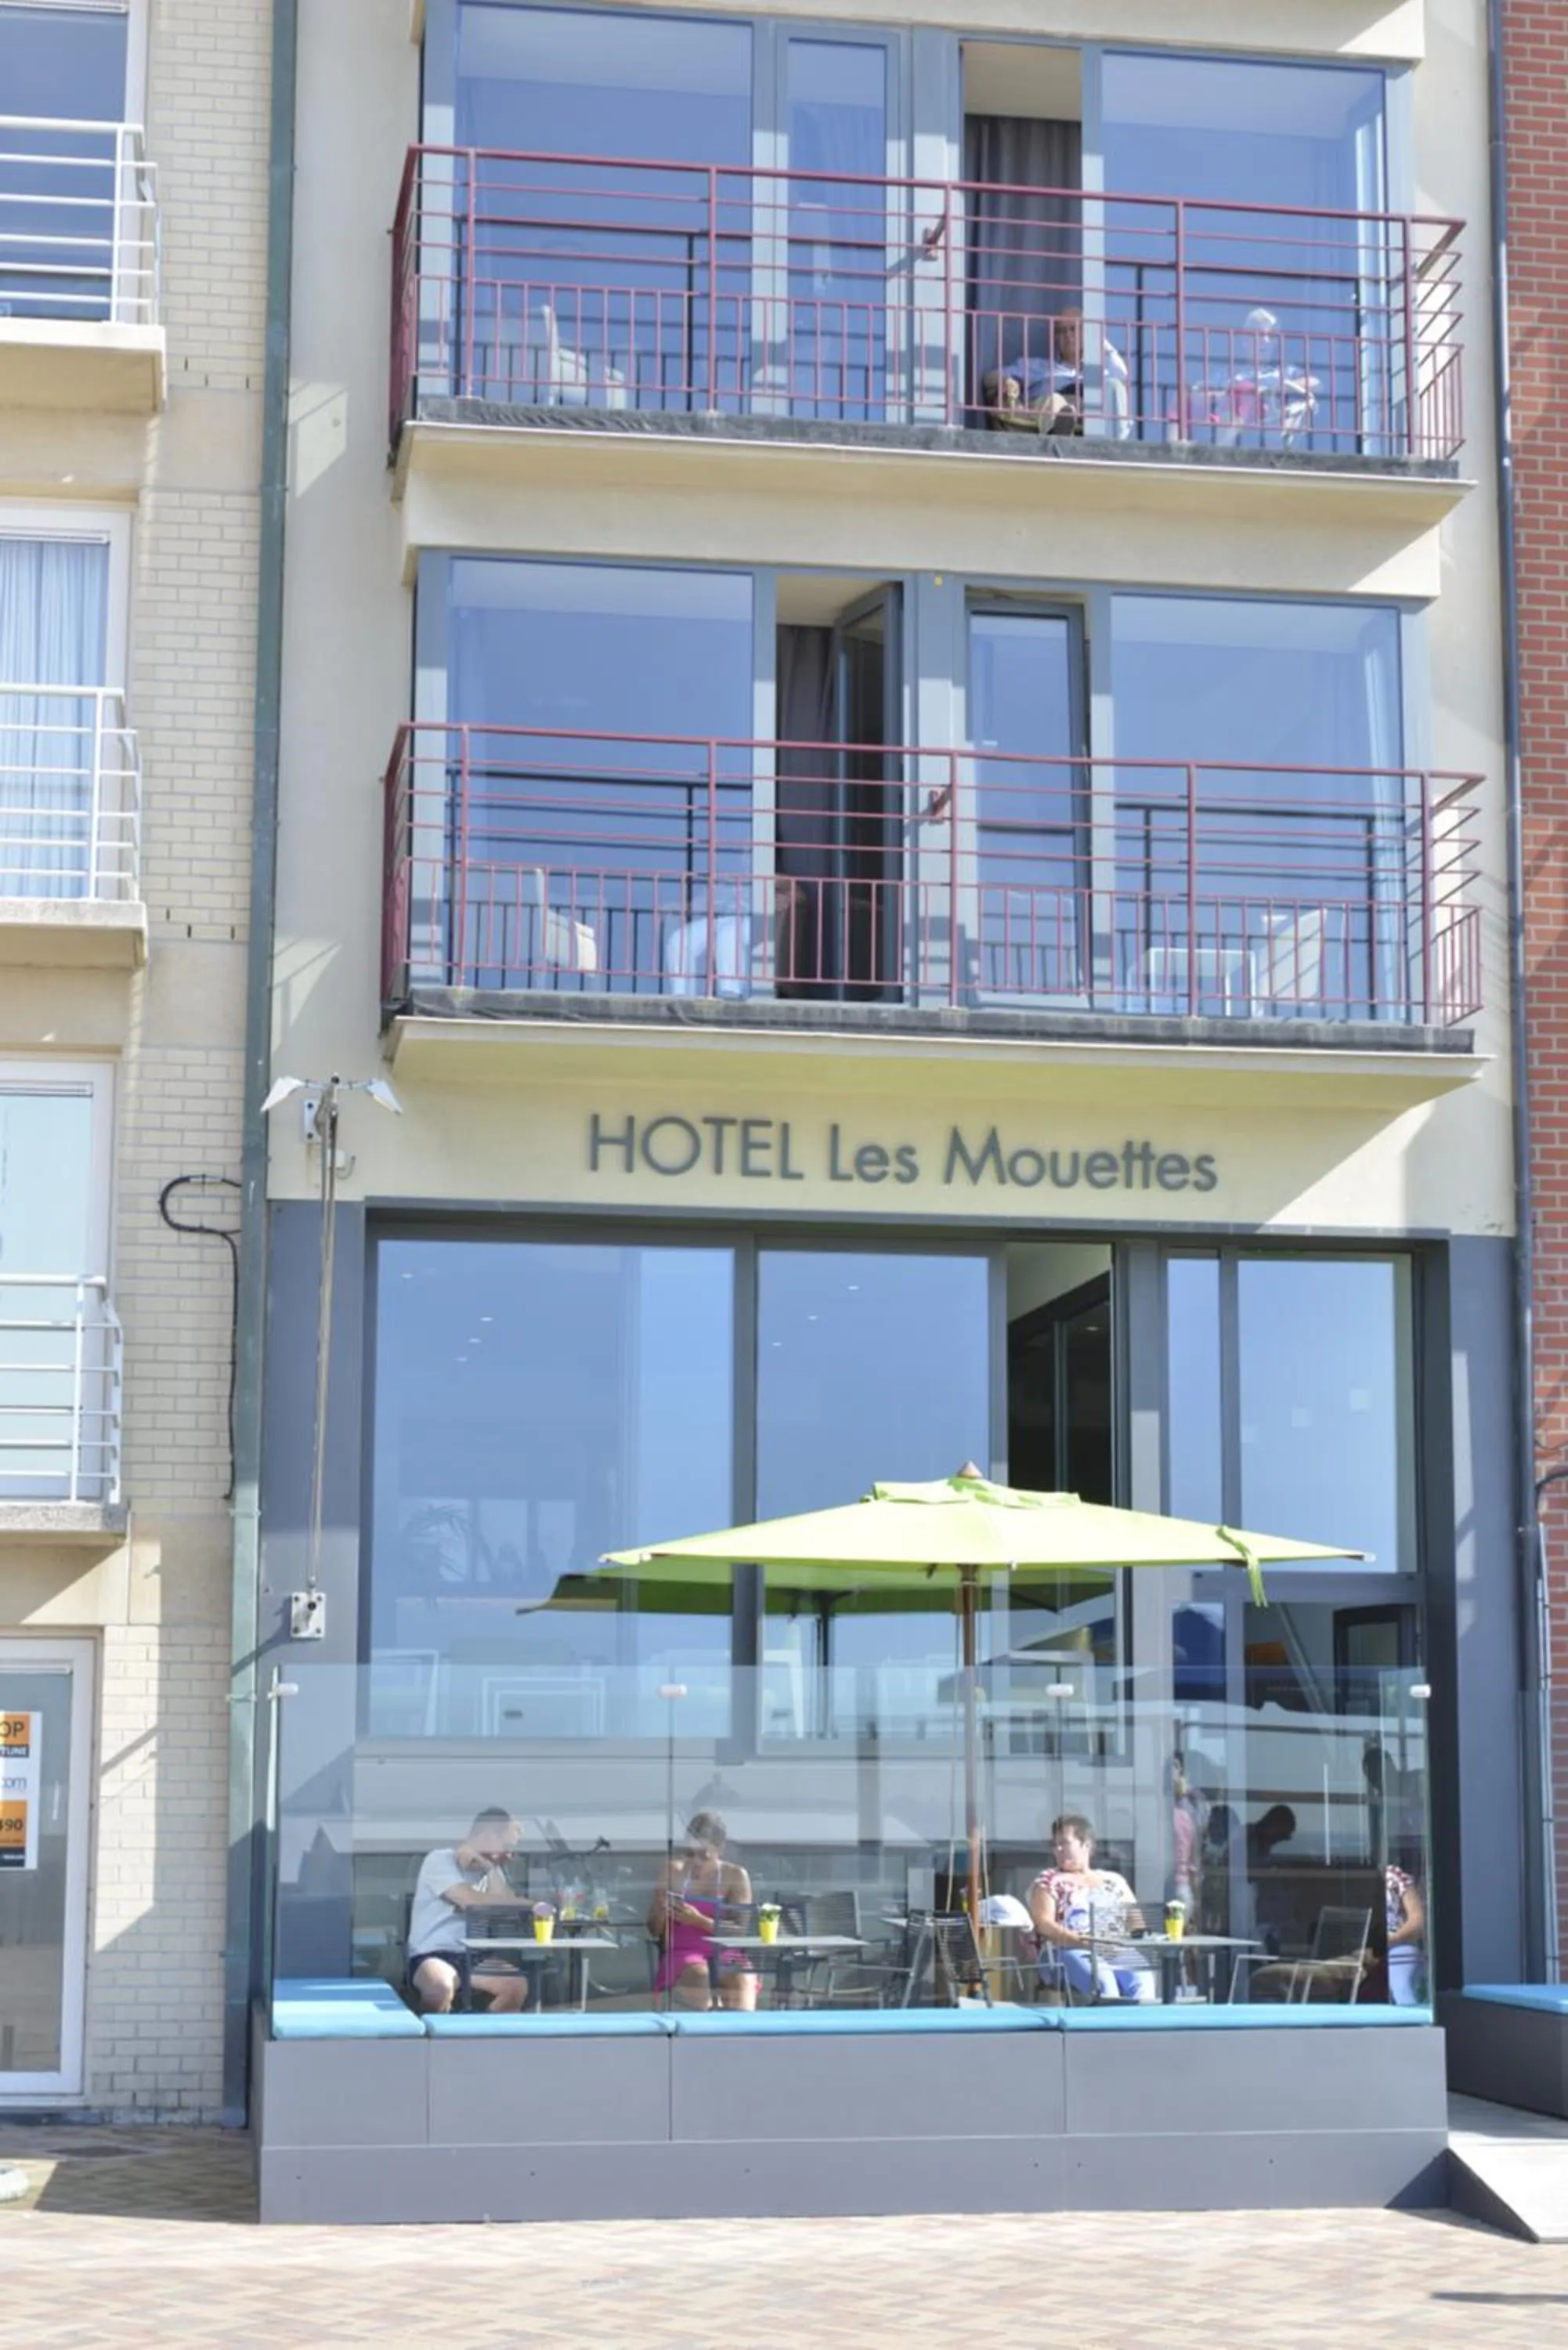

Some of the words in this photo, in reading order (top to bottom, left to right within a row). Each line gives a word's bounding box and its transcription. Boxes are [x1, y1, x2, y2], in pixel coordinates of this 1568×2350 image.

[589, 1113, 804, 1180] HOTEL
[829, 1123, 919, 1184] Les
[943, 1126, 1218, 1192] Mouettes
